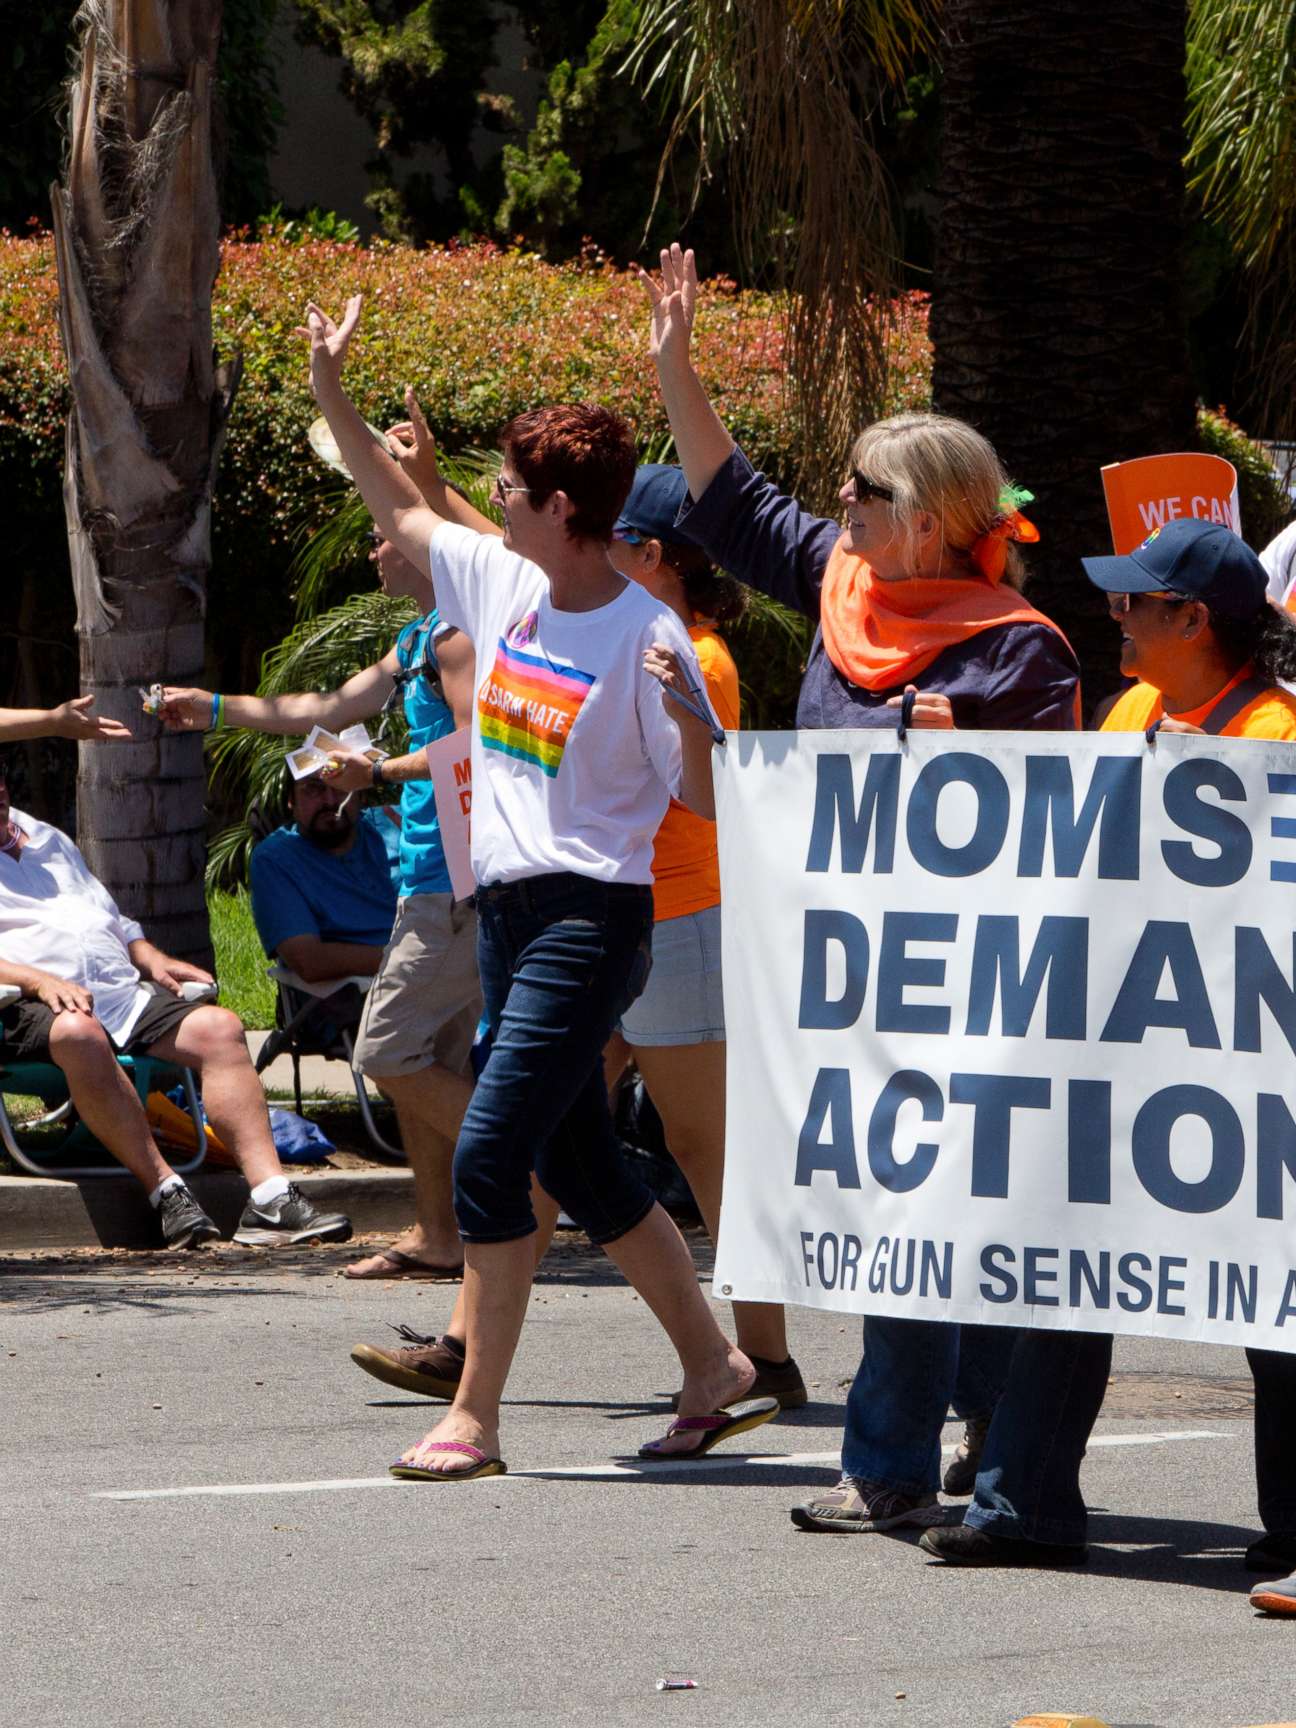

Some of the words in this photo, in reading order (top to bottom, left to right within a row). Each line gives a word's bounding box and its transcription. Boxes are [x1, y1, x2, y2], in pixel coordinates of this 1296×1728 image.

[1138, 496, 1183, 531] WE
[526, 699, 569, 734] HATE
[805, 752, 1253, 888] MOMS
[801, 1231, 862, 1291] FOR
[868, 1238, 954, 1299] GUN
[979, 1243, 1188, 1316] SENSE
[1207, 1260, 1258, 1324] IN
